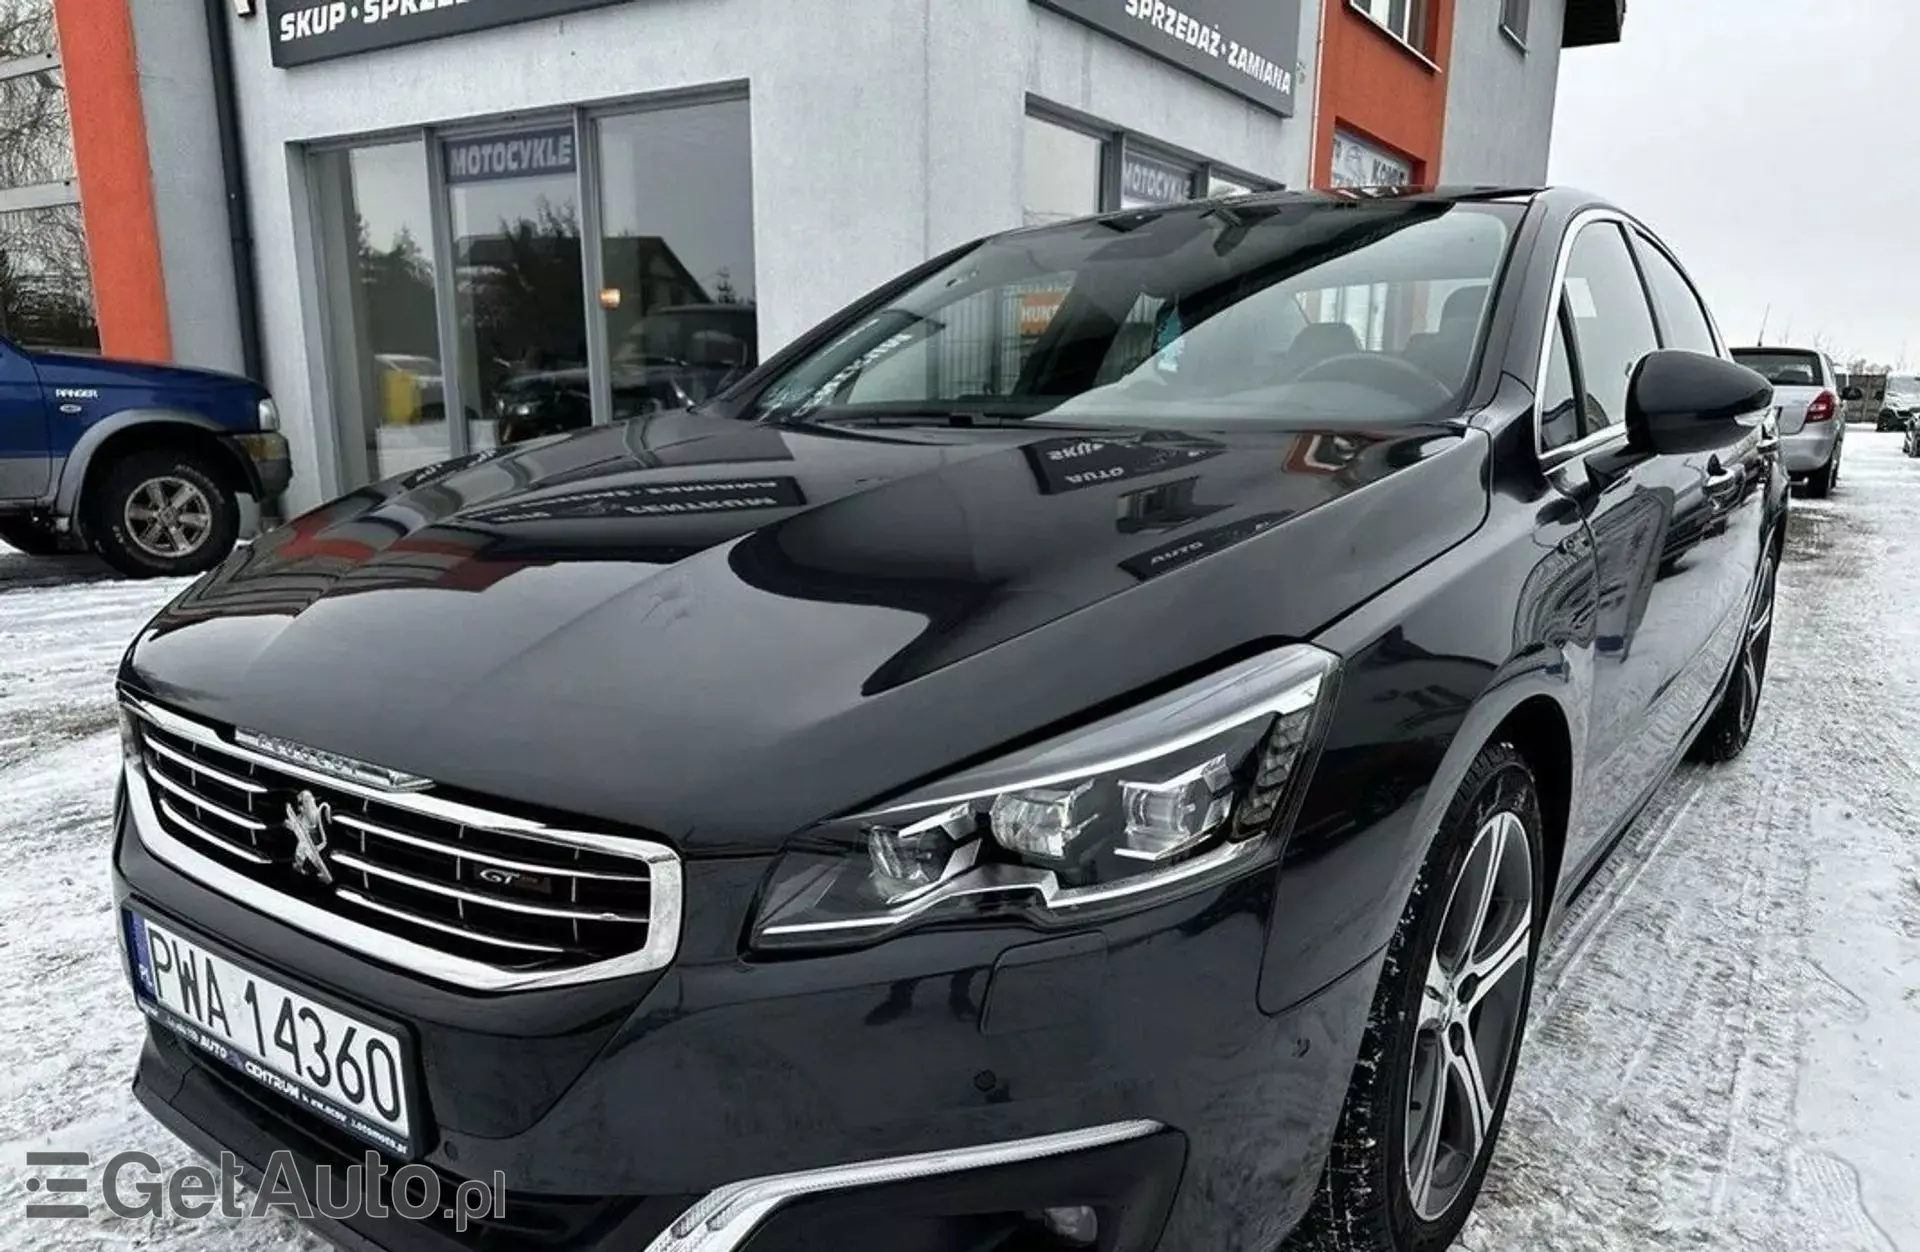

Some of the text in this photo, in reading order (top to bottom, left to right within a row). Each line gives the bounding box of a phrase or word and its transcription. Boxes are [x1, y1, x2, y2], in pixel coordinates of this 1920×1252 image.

[279, 3, 346, 42] SKUP
[1227, 41, 1292, 95] ZAMIANA
[450, 134, 573, 176] MOTOCYKLE
[147, 926, 401, 1122] PWA 14360
